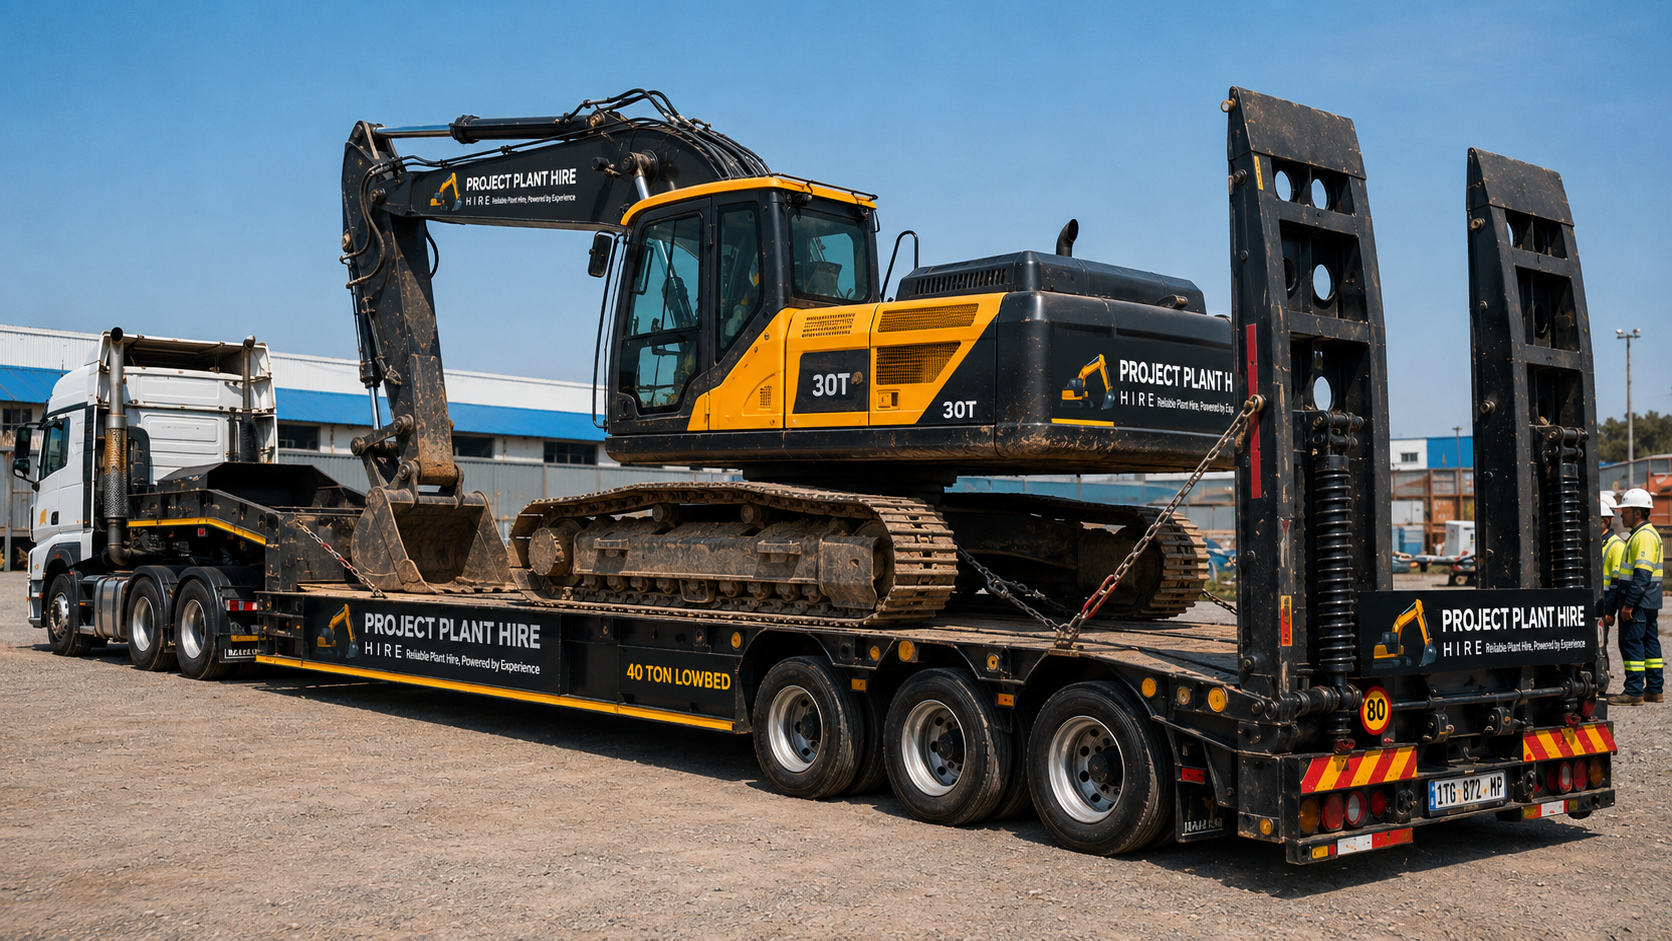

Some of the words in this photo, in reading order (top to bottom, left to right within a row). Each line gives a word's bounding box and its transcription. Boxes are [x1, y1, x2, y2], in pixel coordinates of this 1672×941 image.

[466, 174, 512, 191] PROJECT
[514, 171, 548, 188] PLANT
[551, 168, 576, 185] HIRE
[466, 196, 490, 205] HIRE
[813, 373, 850, 396] 30T
[1120, 360, 1180, 386] PROJECT
[1184, 367, 1223, 391] PLANT
[943, 401, 977, 418] 30T
[1121, 391, 1154, 407] HIRE
[1442, 608, 1509, 632] PROJECT
[1513, 606, 1554, 629] PLANT
[1558, 606, 1585, 627] HIRE
[365, 613, 435, 639] PROJECT
[440, 618, 494, 644] PLANT
[499, 623, 540, 649] HIRE
[365, 642, 402, 658] HIRE
[462, 655, 490, 668] Powered
[491, 659, 499, 672] by
[501, 660, 540, 674] Experience
[1444, 640, 1482, 657] HIRE
[626, 663, 643, 681] 40
[645, 665, 672, 684] TON
[675, 668, 731, 690] LOWBED
[1367, 698, 1385, 721] 80
[1463, 778, 1481, 801] 872
